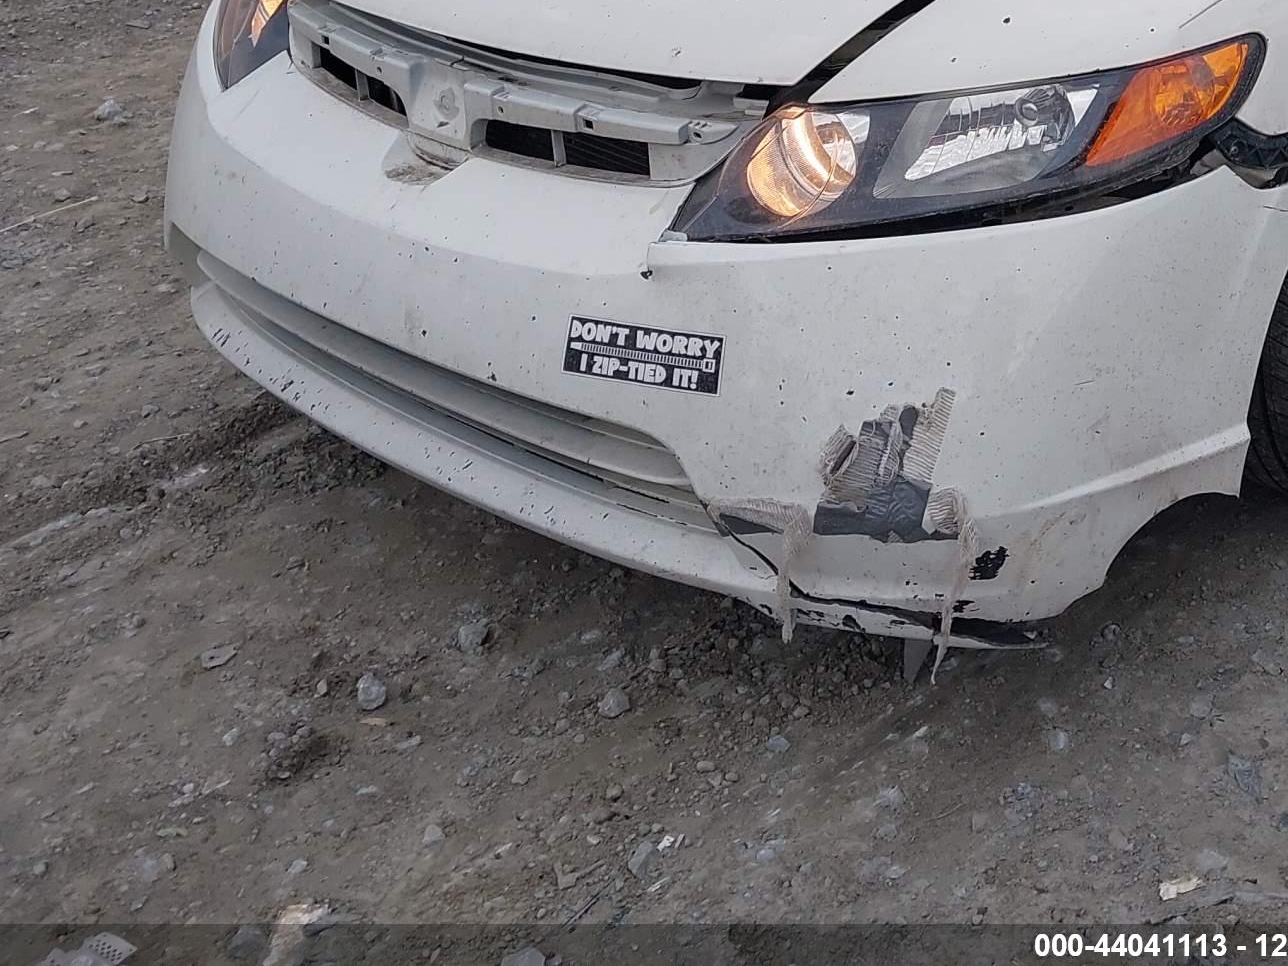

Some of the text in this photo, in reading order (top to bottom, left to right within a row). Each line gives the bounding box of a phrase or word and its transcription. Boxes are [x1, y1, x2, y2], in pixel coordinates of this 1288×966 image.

[570, 319, 721, 359] DON'T WORRY
[579, 353, 699, 390] I ZIP-TIED IT!
